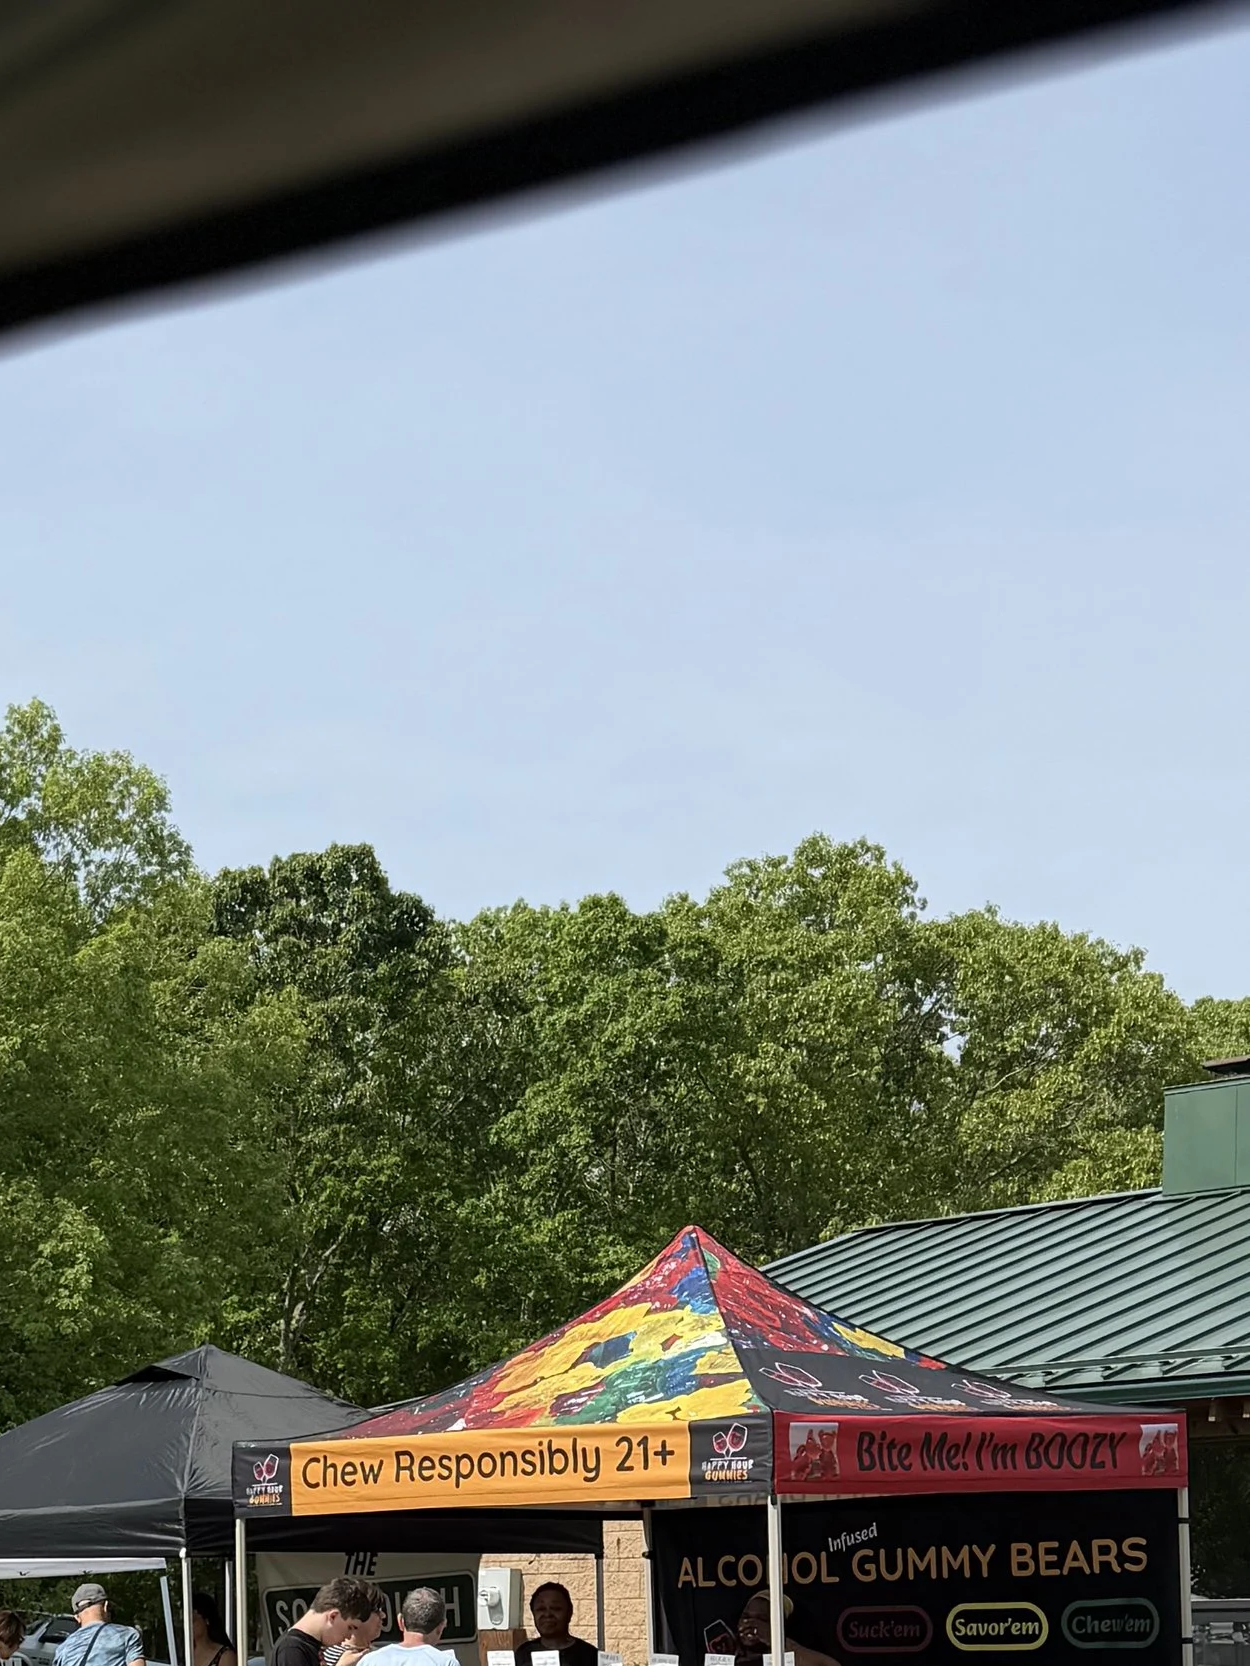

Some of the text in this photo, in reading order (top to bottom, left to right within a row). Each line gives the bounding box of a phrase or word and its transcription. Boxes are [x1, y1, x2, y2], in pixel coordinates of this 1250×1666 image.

[856, 1430, 1128, 1472] Bite Me! I'm BOOZY
[302, 1435, 675, 1490] Chew Responsibly 21+
[701, 1458, 754, 1471] HAPPY HOUR
[704, 1469, 748, 1481] GUMMIES
[828, 1521, 878, 1552] Infused
[344, 1551, 378, 1576] THE
[851, 1544, 996, 1583] GUMMY
[1010, 1536, 1148, 1577] BEARS
[848, 1619, 921, 1639] Suck'em
[954, 1617, 1040, 1637] Savor'em
[1071, 1615, 1150, 1635] Chew'em
